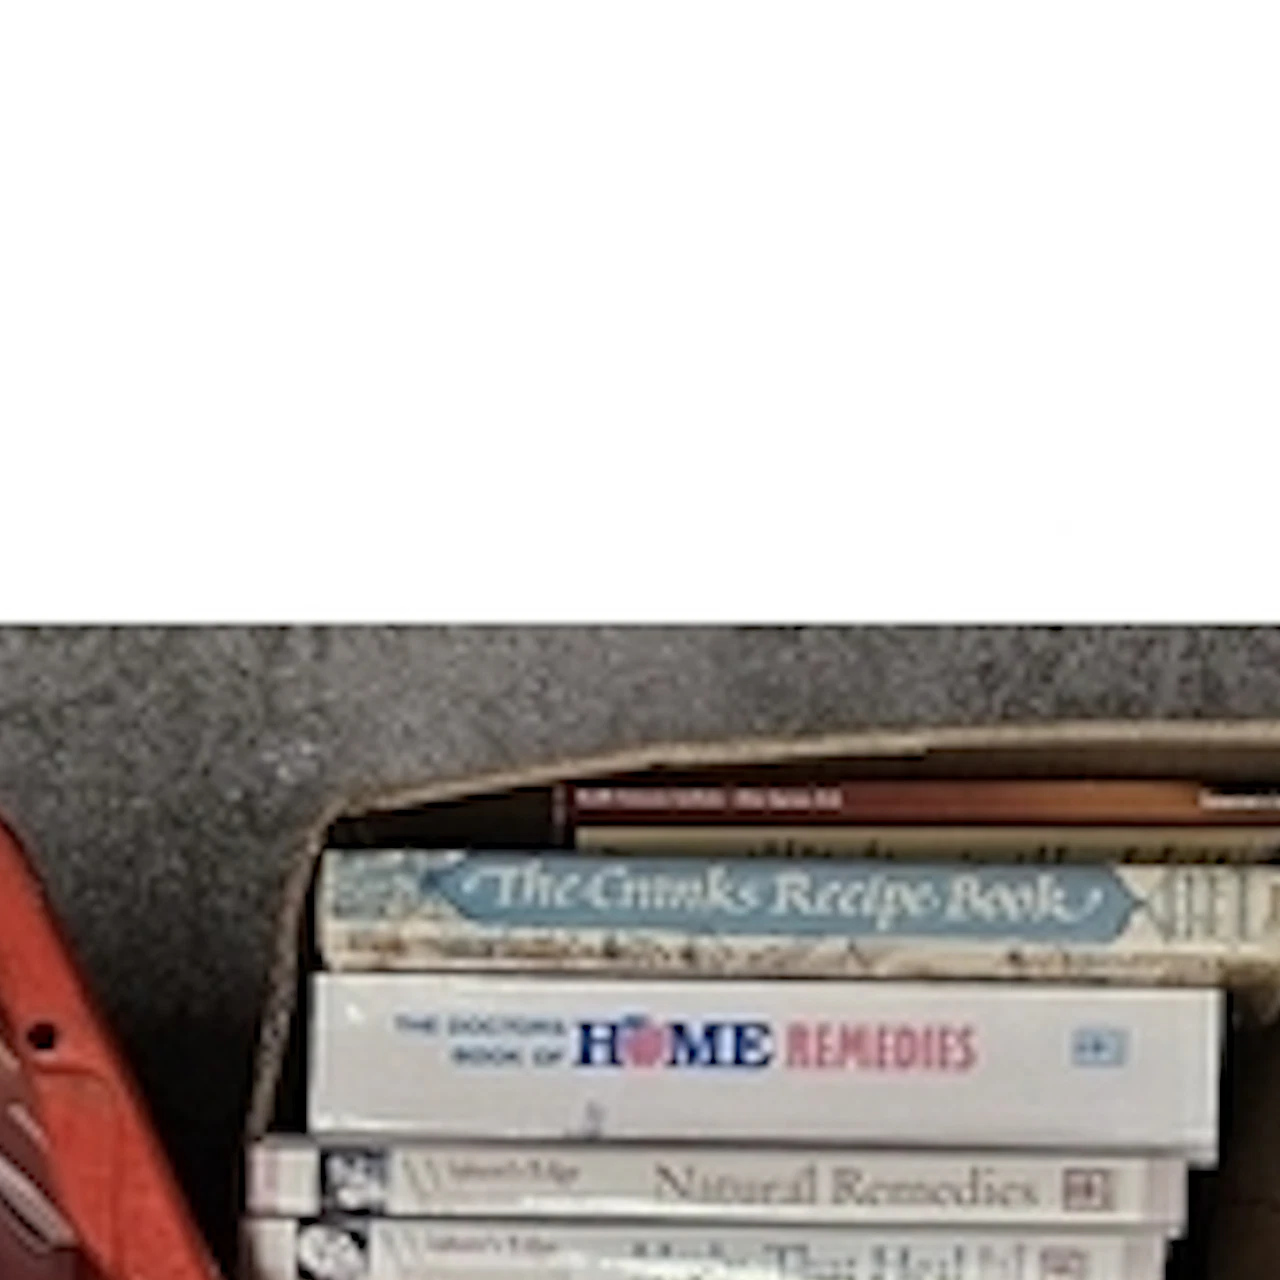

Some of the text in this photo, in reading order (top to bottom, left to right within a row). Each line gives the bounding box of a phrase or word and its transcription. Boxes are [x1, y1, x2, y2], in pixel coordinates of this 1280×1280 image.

[768, 872, 940, 930] Recipe
[946, 873, 1103, 921] Book
[573, 1017, 979, 1071] HOME REMEDIES
[654, 1162, 1041, 1209] Natural Remedies
